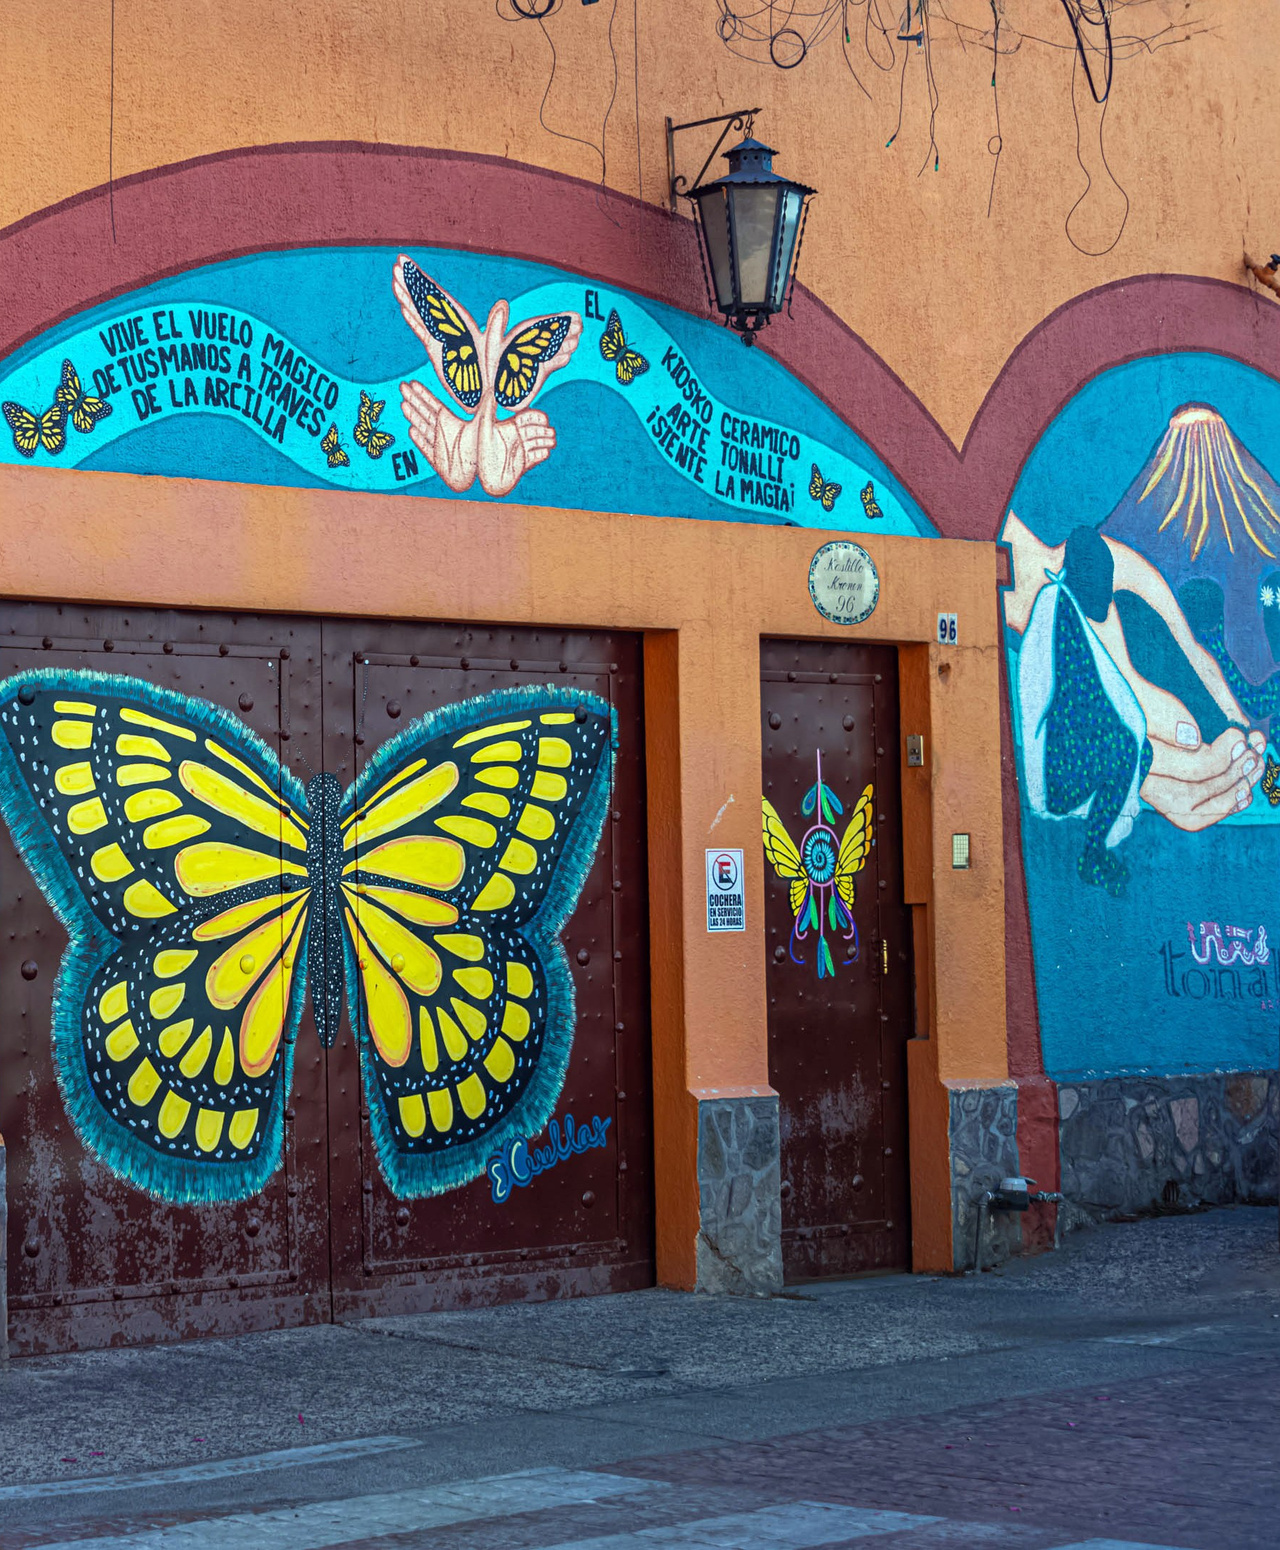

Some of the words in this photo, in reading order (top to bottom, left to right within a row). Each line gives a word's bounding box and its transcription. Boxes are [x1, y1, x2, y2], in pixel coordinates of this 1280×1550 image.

[585, 289, 605, 322] EL
[99, 316, 150, 357] VIVE
[152, 310, 183, 342] EL
[188, 309, 253, 348] VUELO
[261, 333, 339, 410] MAGICO
[92, 363, 122, 400] DE
[117, 348, 160, 387] TUS
[157, 343, 232, 377] MANOS
[237, 352, 252, 383] A
[258, 361, 327, 437] TRAVES
[661, 345, 713, 424] KIOSKO
[721, 412, 800, 460] CERAMICO
[131, 383, 162, 421] DE
[169, 377, 199, 408] LA
[204, 376, 287, 444] ARCILLA
[666, 402, 710, 454] ARTE
[721, 440, 784, 484] TONALLI
[391, 449, 419, 481] EN
[715, 470, 735, 500] LA
[835, 595, 856, 613] 96
[939, 618, 957, 640] 96
[709, 893, 742, 906] COCHERA
[709, 907, 717, 917] EN
[717, 907, 742, 917] SERVICIO
[710, 917, 719, 926] LAS
[719, 917, 726, 926] 24
[726, 917, 742, 926] HORAS
